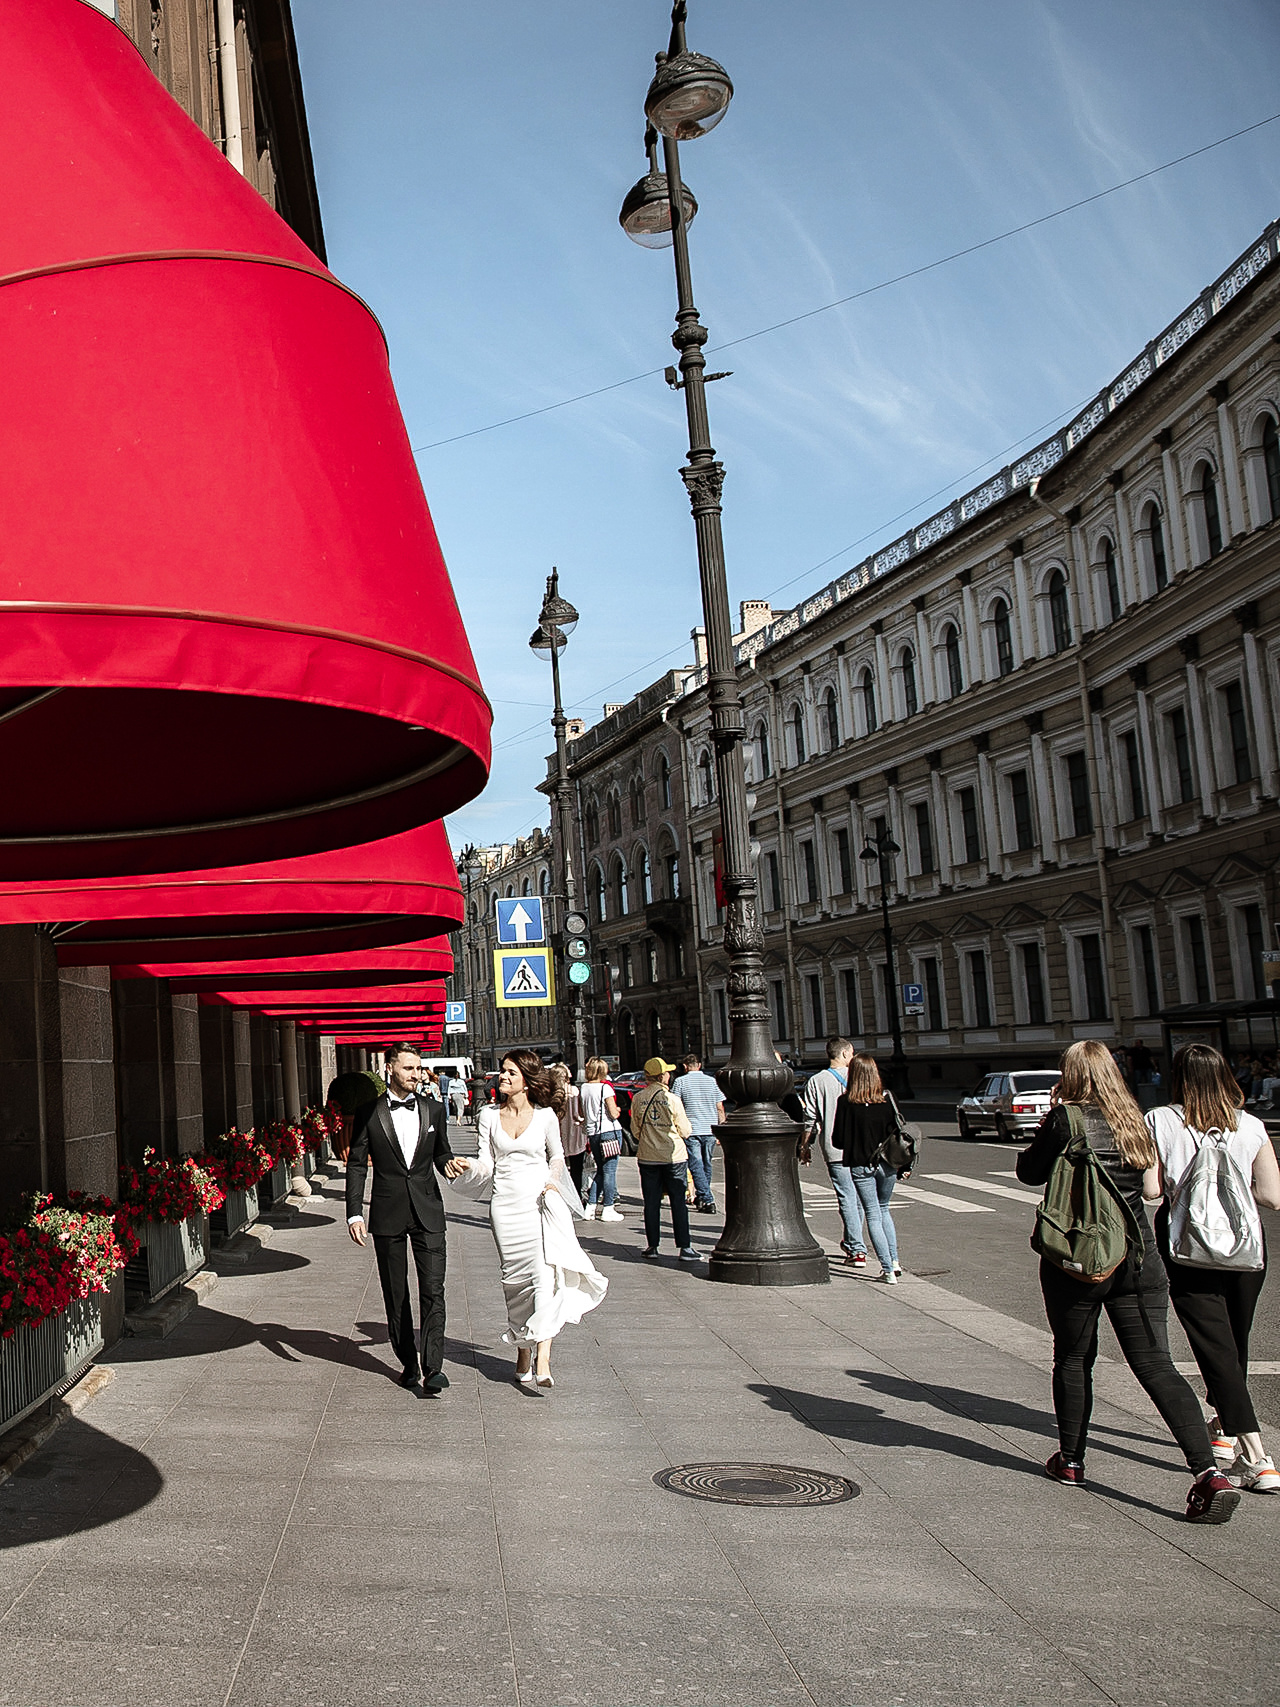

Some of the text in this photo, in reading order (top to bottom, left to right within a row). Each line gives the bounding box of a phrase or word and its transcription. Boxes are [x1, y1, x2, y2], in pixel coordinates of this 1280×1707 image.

[576, 940, 586, 956] 5
[908, 986, 920, 1002] P
[450, 1004, 463, 1021] P
